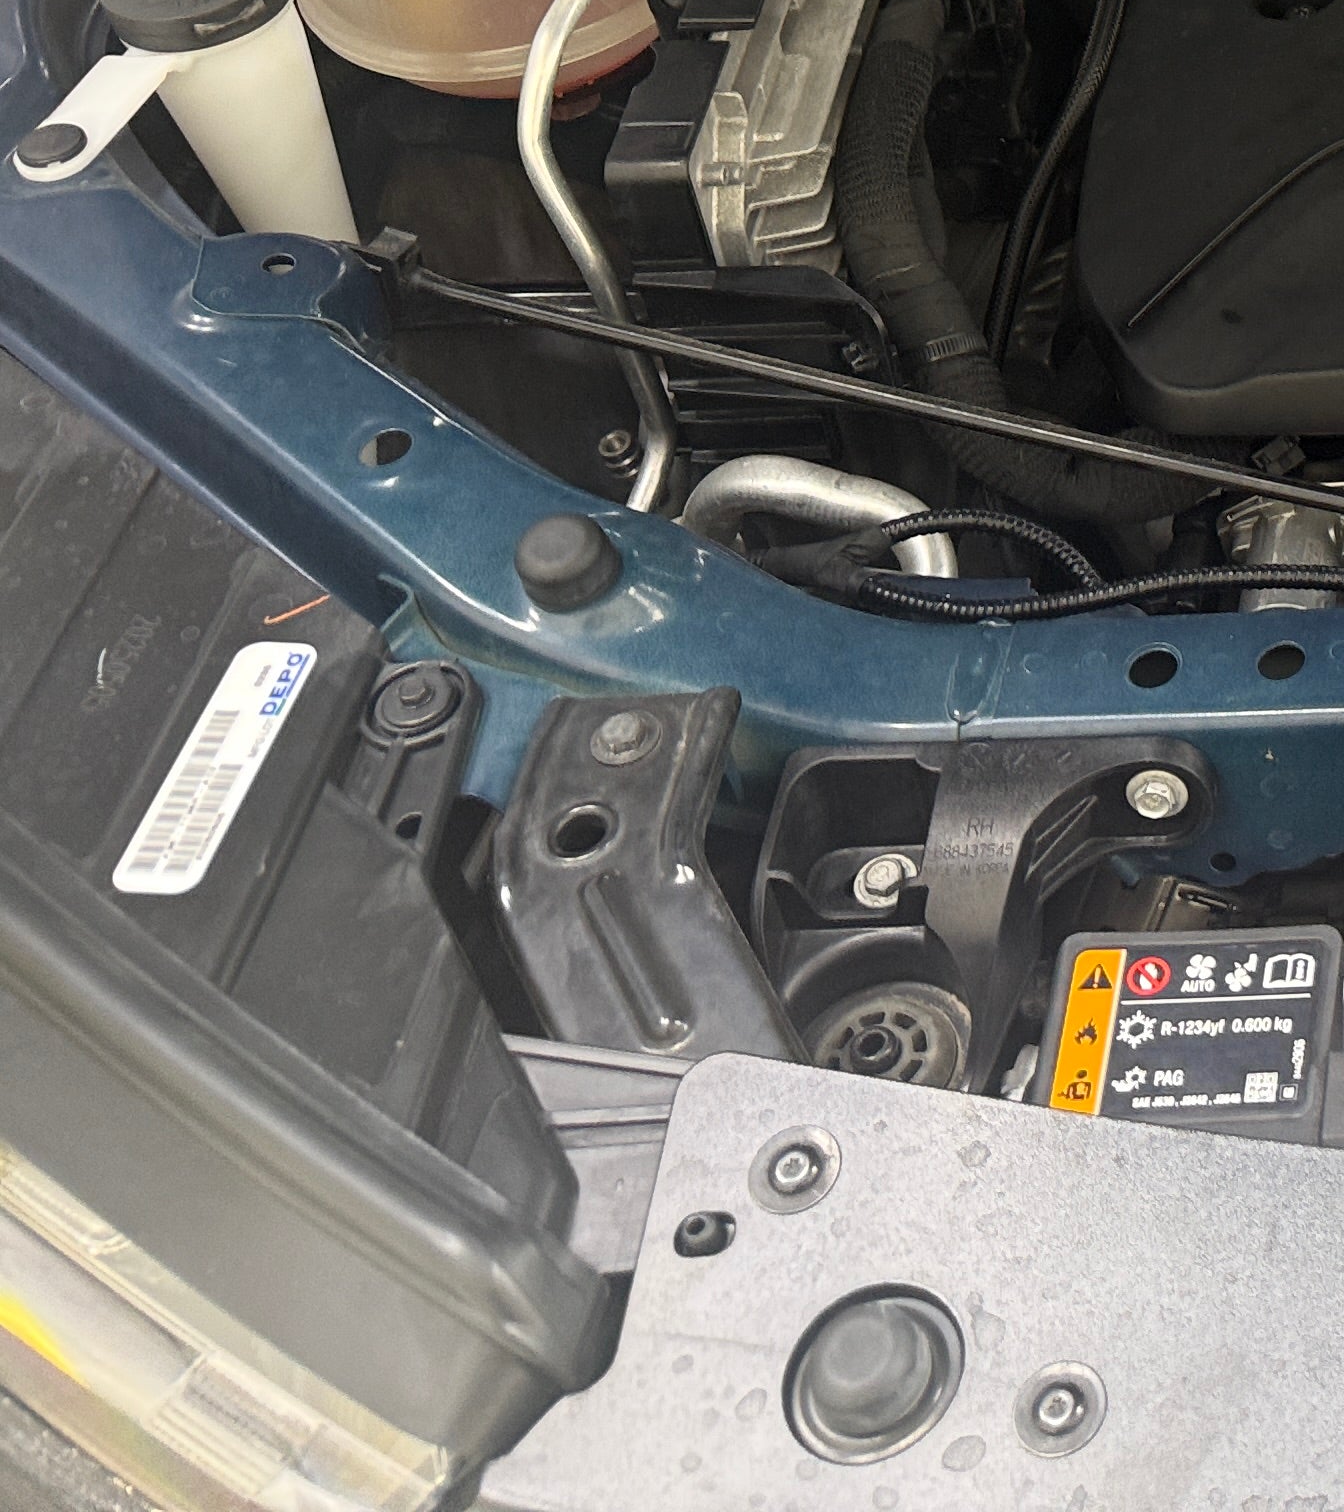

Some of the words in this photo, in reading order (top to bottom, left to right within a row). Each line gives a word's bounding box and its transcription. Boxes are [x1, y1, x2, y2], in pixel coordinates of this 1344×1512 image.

[259, 652, 307, 716] DEPO
[967, 817, 994, 836] RH
[1181, 978, 1215, 992] AUTO
[1160, 1019, 1225, 1037] R-1234yf
[1232, 1017, 1272, 1033] 0.600
[1274, 1016, 1292, 1034] kg
[1154, 1070, 1184, 1086] PAG
